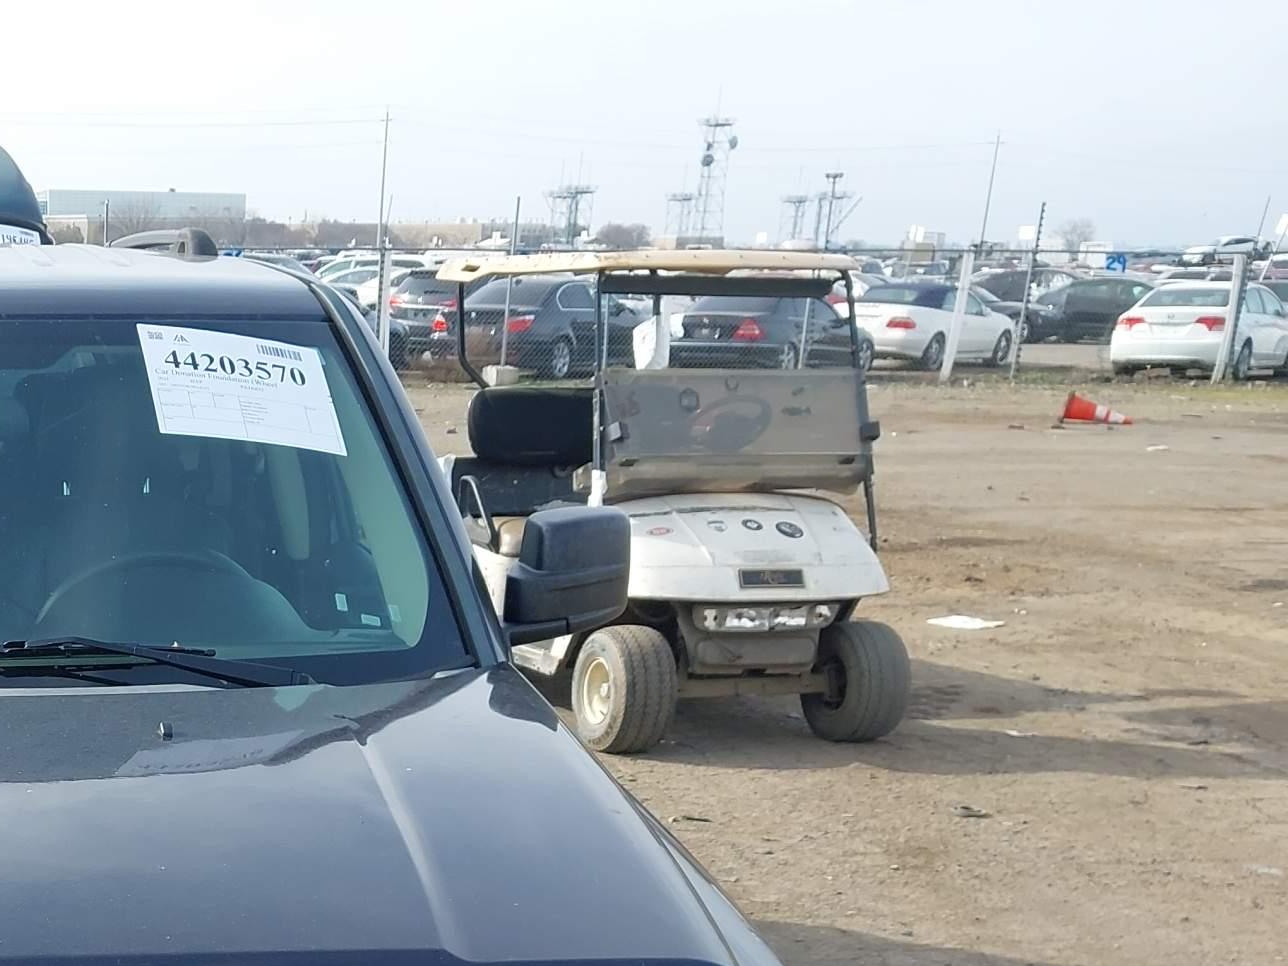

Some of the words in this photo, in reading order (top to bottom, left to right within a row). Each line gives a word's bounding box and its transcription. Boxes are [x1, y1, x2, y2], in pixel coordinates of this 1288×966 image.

[1105, 254, 1127, 273] 29
[154, 367, 169, 376] Car
[164, 349, 306, 387] 44203570
